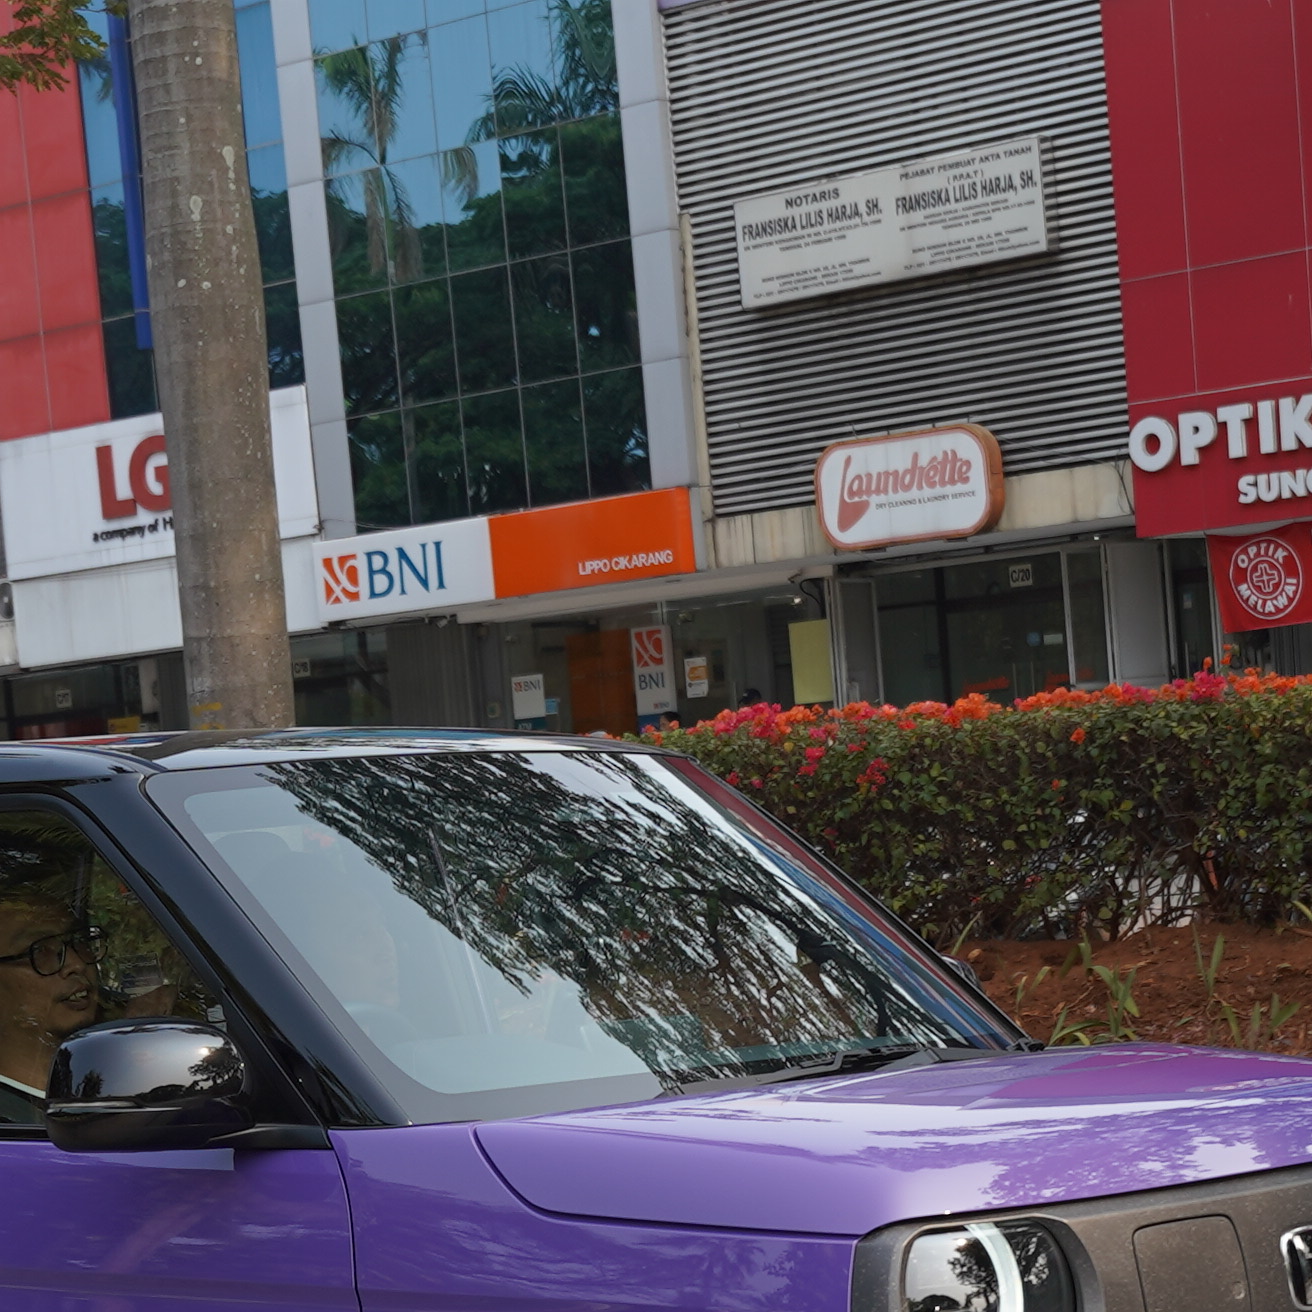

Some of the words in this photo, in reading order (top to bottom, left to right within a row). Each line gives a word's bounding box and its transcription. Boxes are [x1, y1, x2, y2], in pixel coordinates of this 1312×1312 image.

[899, 167, 935, 181] PEJABAT
[938, 157, 976, 172] PEMBUAT
[978, 153, 1001, 165] AKTA
[1003, 145, 1032, 158] TANAH
[785, 188, 840, 210] NOTARIS
[895, 188, 951, 216] FRANSISKA
[953, 181, 978, 204] LILIS
[980, 174, 1018, 198] HARJA,
[1019, 169, 1038, 190] SH.
[742, 215, 797, 243] FRANSISKA
[799, 209, 824, 230] LILIS
[826, 201, 864, 225] HARJA,
[865, 197, 882, 216] SH.
[92, 533, 99, 542] a
[100, 525, 146, 541] company
[148, 518, 159, 533] of
[578, 558, 610, 576] LIPPO
[611, 549, 674, 571] CIKARANG
[1237, 542, 1288, 568] OPTIK
[363, 540, 447, 600] BNI
[1010, 568, 1031, 583] C/20
[1237, 578, 1297, 613] MELAWAI
[523, 679, 541, 692] BNI
[639, 672, 665, 691] BNI
